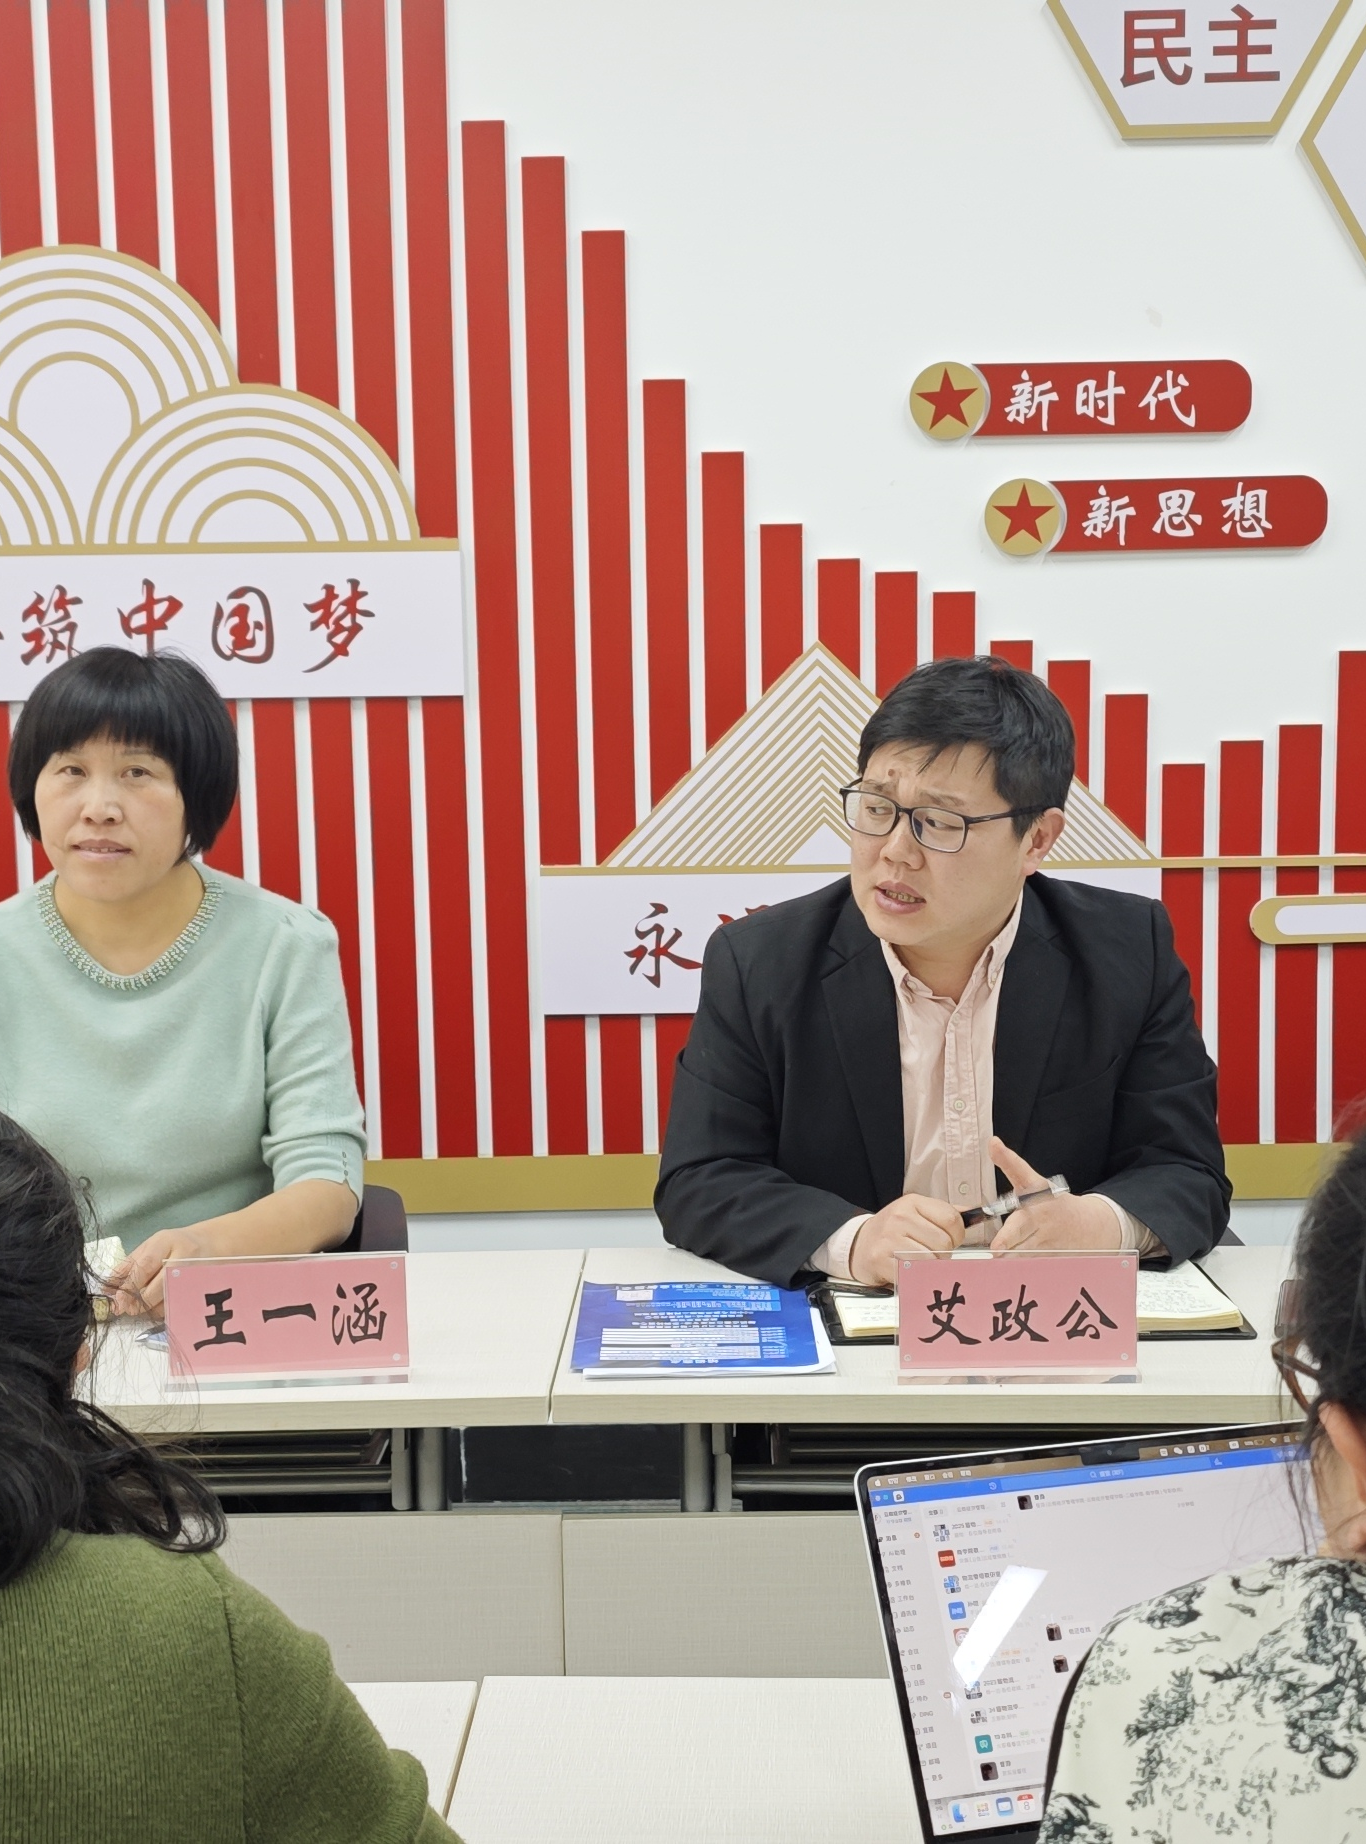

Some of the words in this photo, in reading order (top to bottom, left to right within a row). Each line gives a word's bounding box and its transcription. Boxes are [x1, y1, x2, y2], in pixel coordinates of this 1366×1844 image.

[1119, 6, 1280, 87] 民主
[1004, 370, 1196, 431] 新时代
[1082, 482, 1273, 545] 新思想
[193, 1283, 387, 1351] 王一涵
[918, 1282, 1119, 1345] 艾政公
